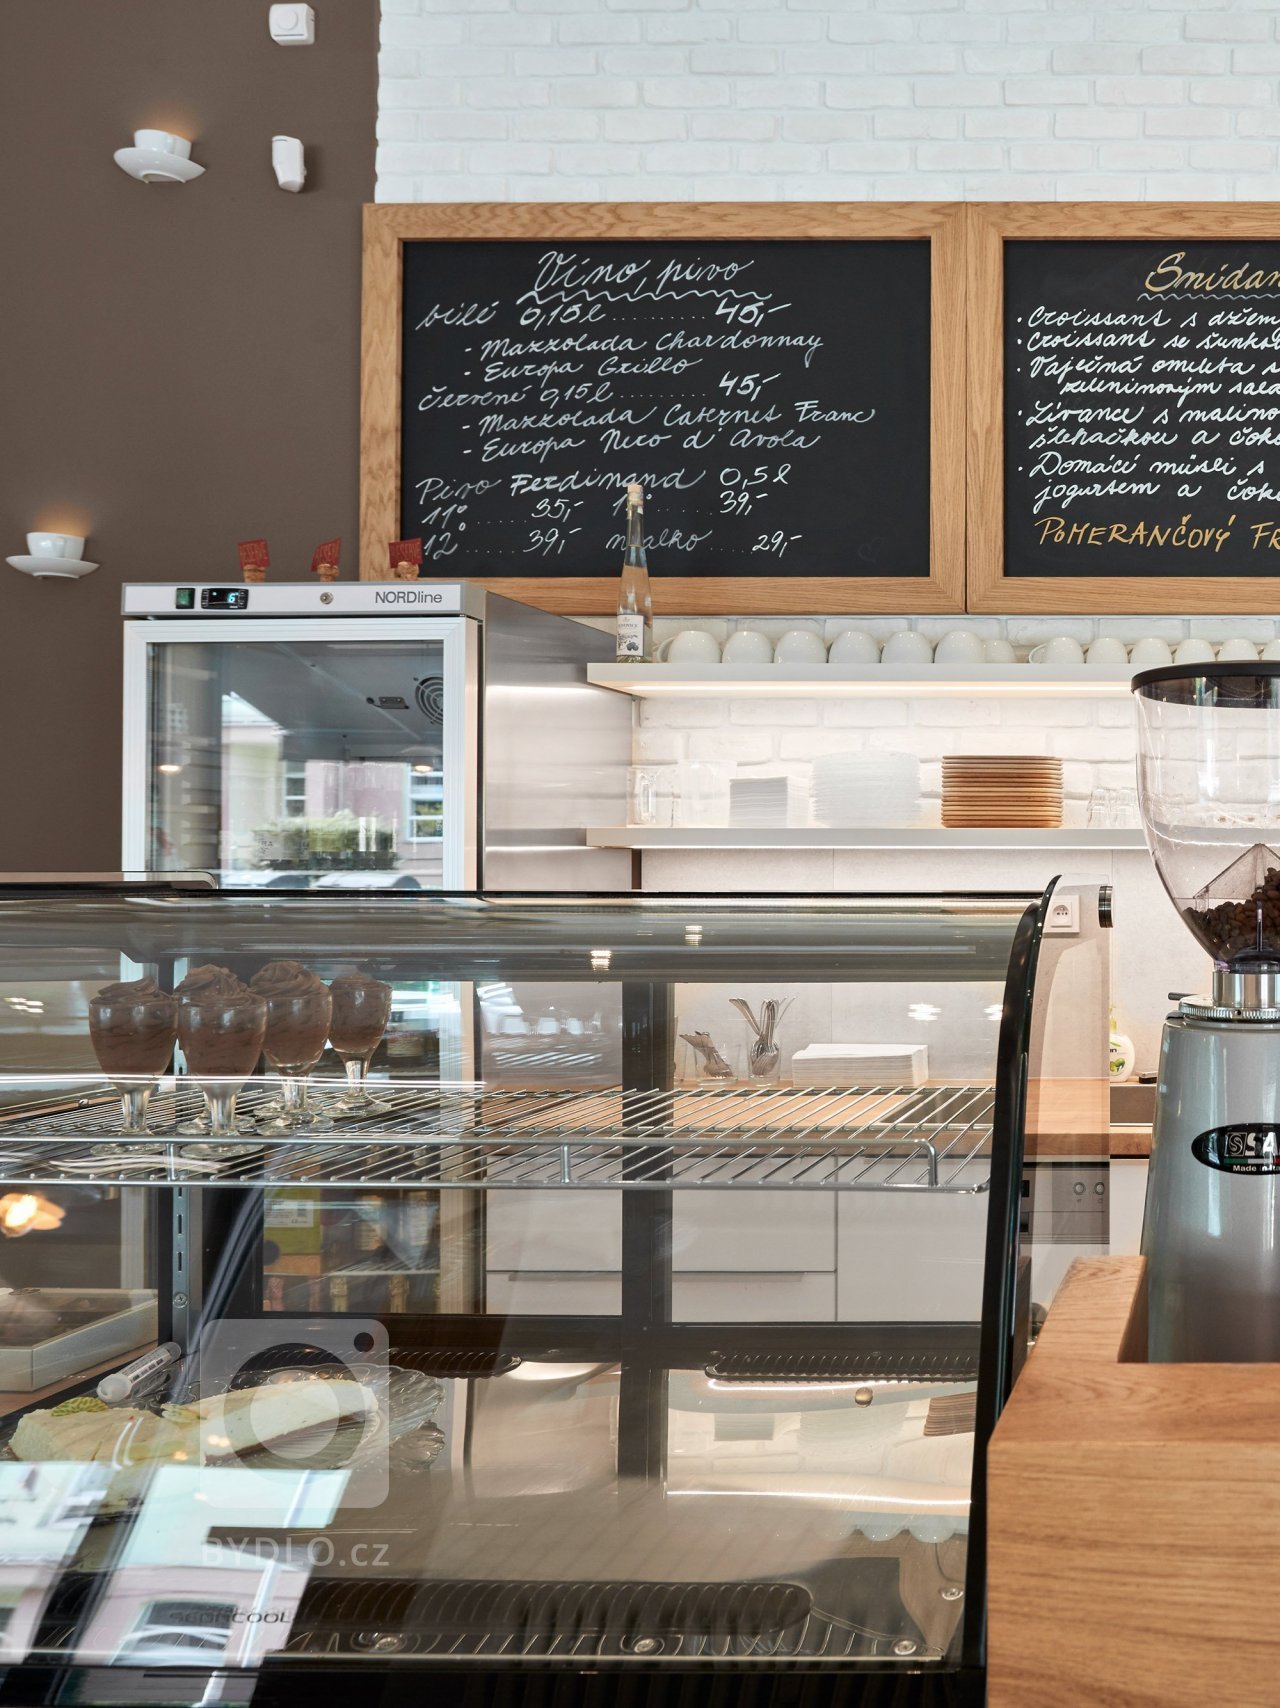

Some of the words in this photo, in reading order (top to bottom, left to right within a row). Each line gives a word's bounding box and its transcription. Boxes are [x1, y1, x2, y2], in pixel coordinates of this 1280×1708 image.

[656, 257, 754, 295] pivo
[415, 301, 499, 330] bílé
[1028, 305, 1171, 328] Croissant
[1180, 312, 1197, 328] s
[480, 334, 647, 361] Mazzolada
[656, 330, 823, 368] Chardonnay
[1027, 330, 1156, 352] Croissant
[1163, 334, 1190, 349] se
[484, 361, 583, 388] Europa
[598, 356, 703, 376] Grillo
[1030, 355, 1144, 384] Vaječná
[1151, 357, 1255, 376] omeleta
[418, 385, 532, 411] červené
[478, 406, 657, 437] Mazzolada
[794, 400, 875, 423] Franc
[1026, 400, 1144, 426] Lívance
[1153, 408, 1169, 425] s
[481, 437, 585, 463] Europa
[1028, 426, 1178, 450] šlehačkou
[1191, 429, 1221, 445] a
[1029, 451, 1141, 478] Domácí
[1149, 453, 1237, 476] müsli
[1246, 460, 1265, 476] s
[415, 478, 501, 504] Pivo
[510, 468, 706, 496] Ferdinand
[1032, 478, 1160, 515] jogurtem
[1177, 483, 1202, 498] a
[606, 528, 713, 551] nalko
[375, 591, 442, 604] NORDline
